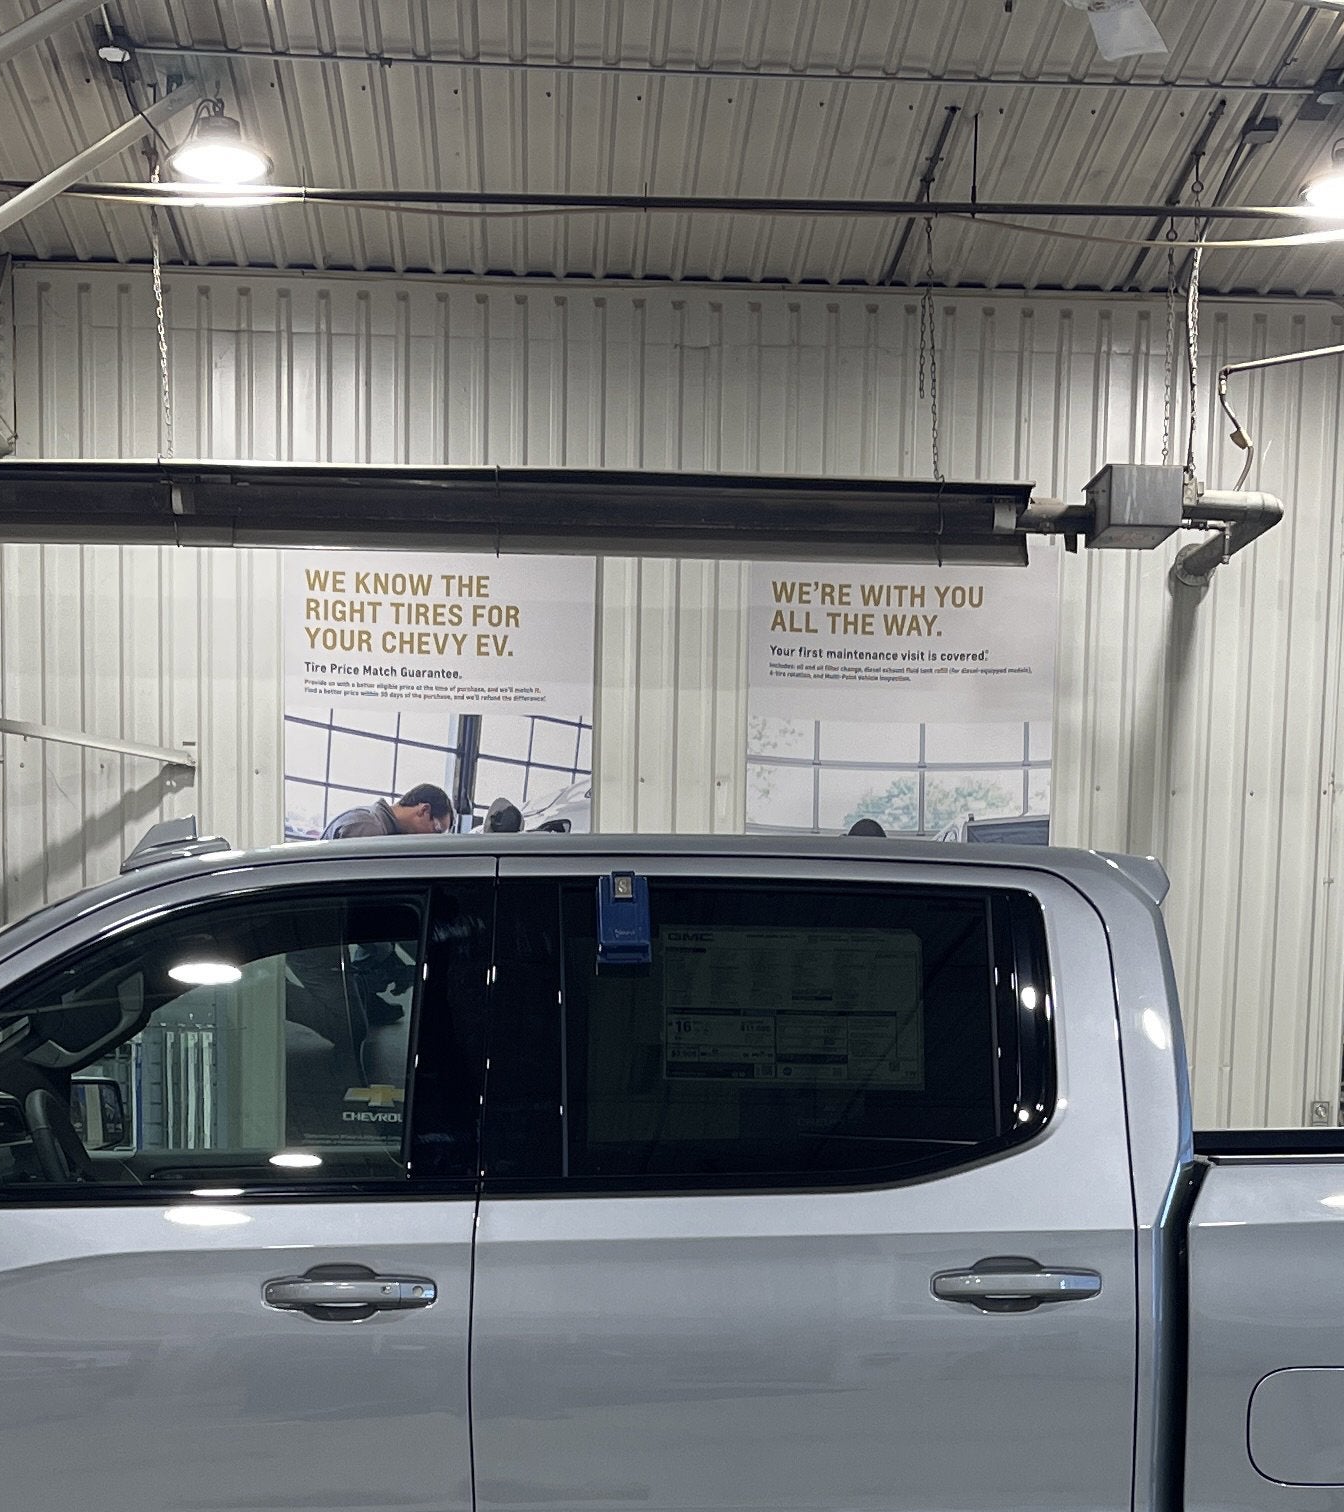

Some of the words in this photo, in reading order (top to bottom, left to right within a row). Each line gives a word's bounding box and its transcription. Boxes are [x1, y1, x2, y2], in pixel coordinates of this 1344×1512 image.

[305, 568, 346, 593] WE
[356, 572, 432, 596] KNOW
[441, 574, 490, 598] THE
[772, 581, 852, 606] WE'RE
[860, 584, 926, 608] WITH
[935, 585, 984, 608] YOU
[306, 598, 382, 623] RIGHT
[390, 602, 463, 627] TIRES
[472, 605, 520, 628] FOR
[771, 610, 818, 633] ALL
[827, 612, 875, 636] THE
[883, 614, 942, 637] WAY.
[305, 627, 372, 652] YOUR
[382, 631, 468, 655] CHEVY
[476, 634, 514, 657] EV.
[770, 645, 795, 657] Your
[798, 646, 823, 659] first
[826, 648, 898, 660] maintenance
[901, 650, 925, 661] visit
[928, 650, 937, 661] is
[304, 661, 327, 673] Tire
[330, 663, 359, 675] Price
[363, 665, 396, 677] Match
[401, 666, 462, 679] Guarantee.
[343, 1112, 403, 1122] CHEVROL
